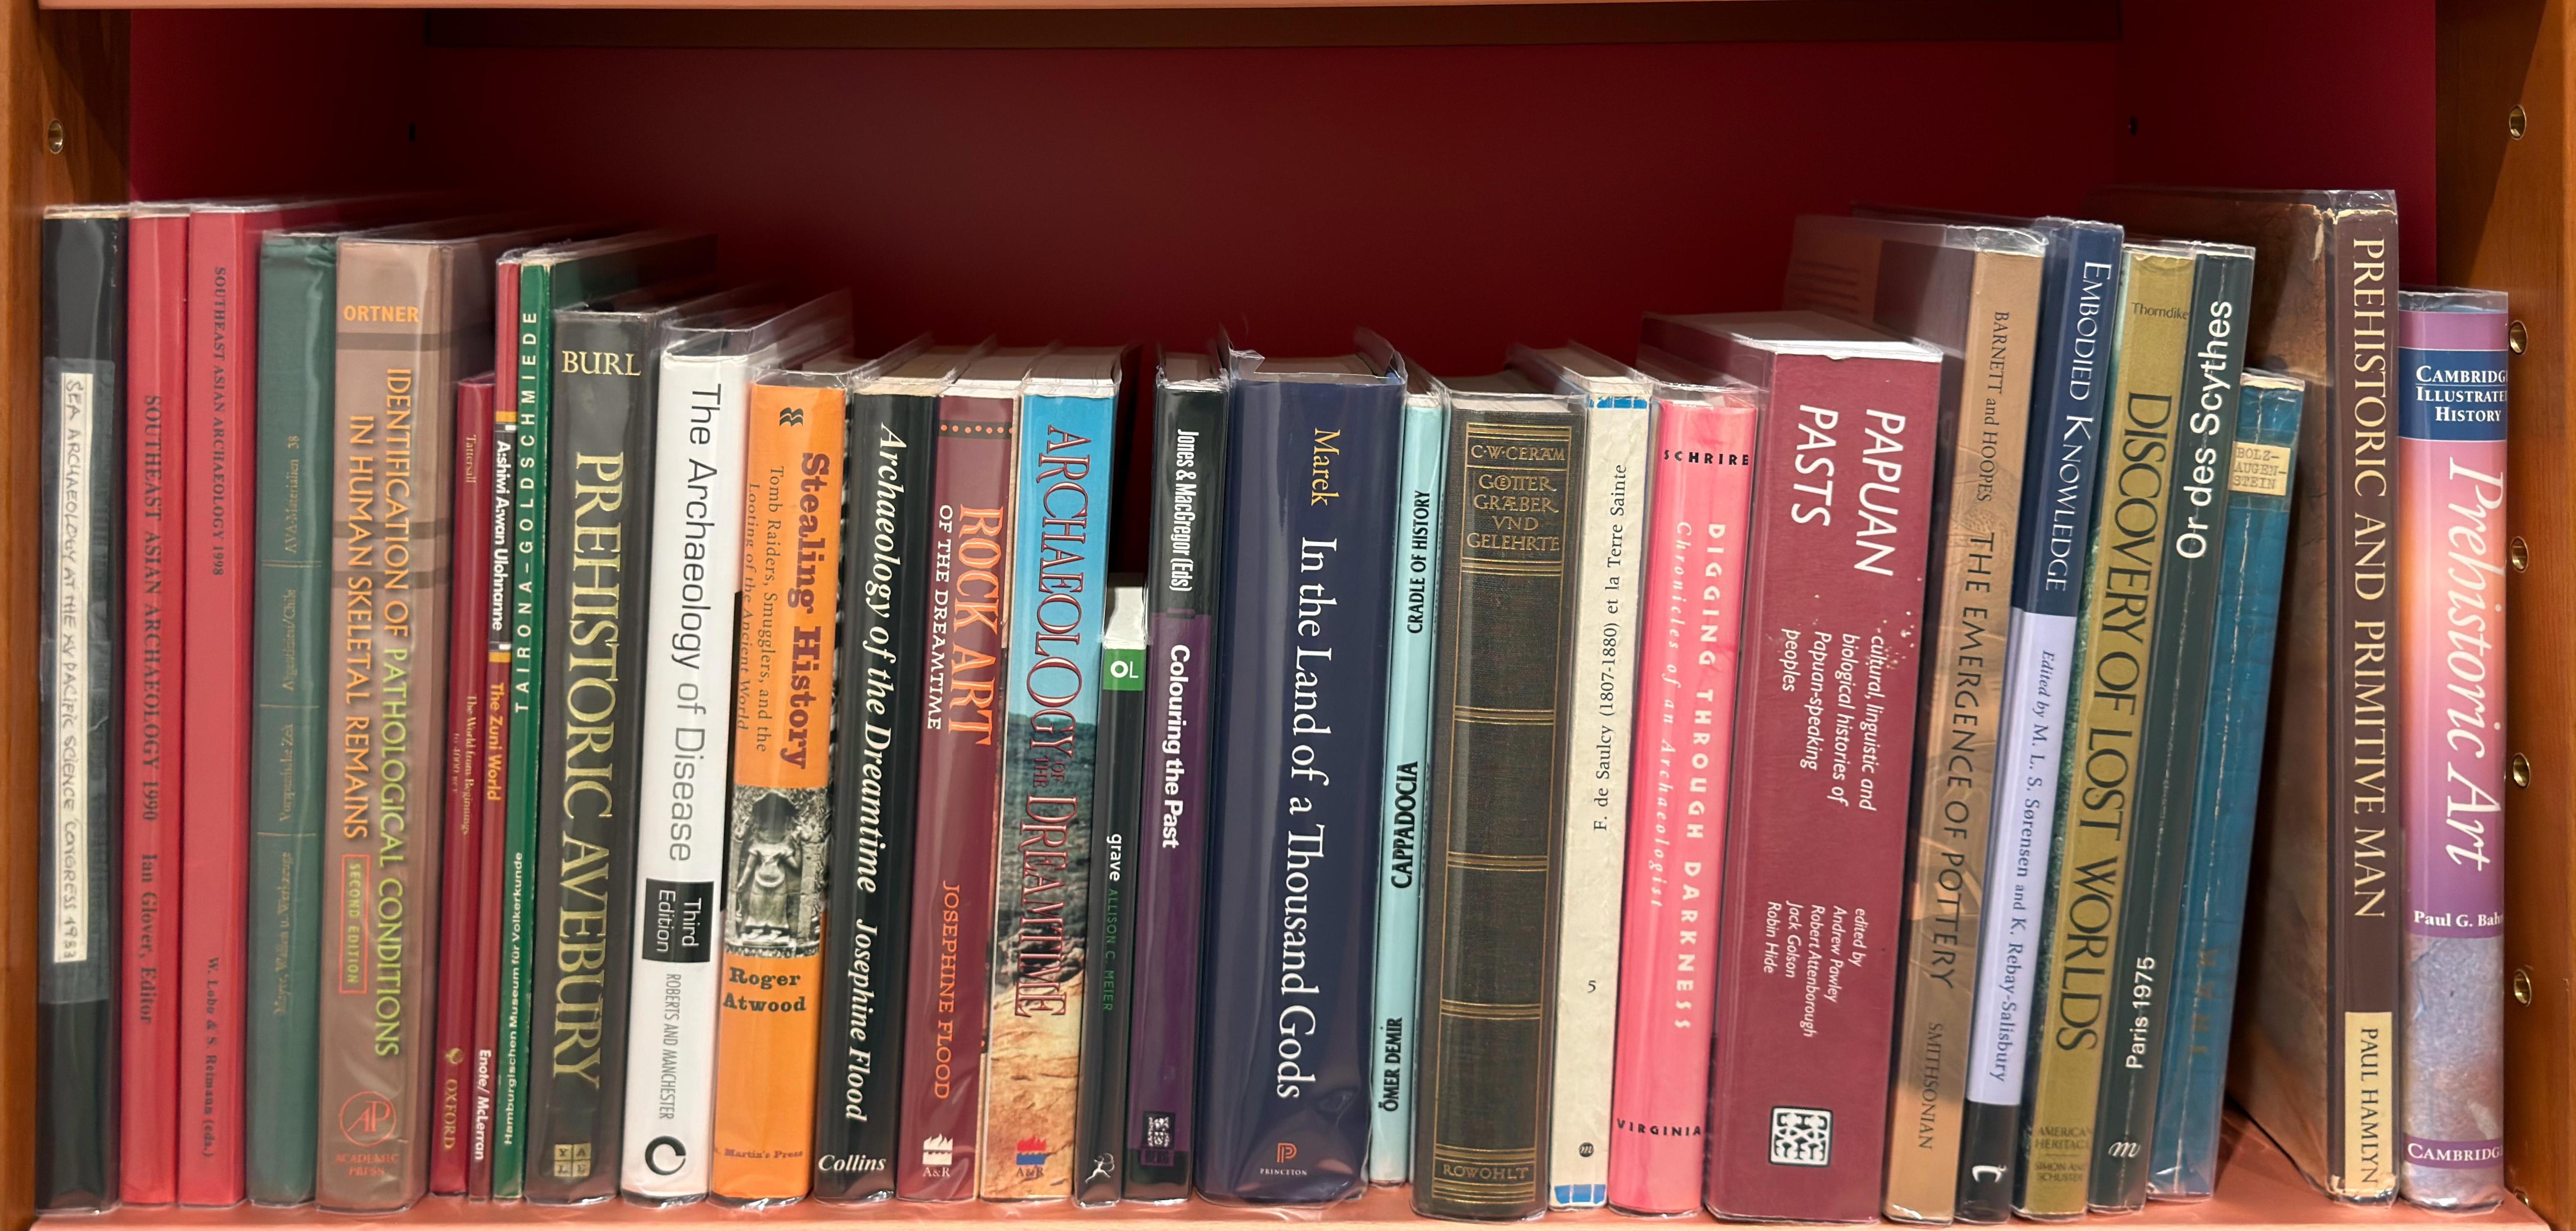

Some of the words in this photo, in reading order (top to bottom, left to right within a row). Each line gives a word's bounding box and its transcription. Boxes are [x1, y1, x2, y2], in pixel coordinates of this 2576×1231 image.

[214, 267, 226, 360] SOUTHEAST
[343, 305, 419, 322] ORTNER
[2069, 261, 2112, 400] EMBODIED
[2132, 303, 2189, 320] Thorndike
[562, 350, 641, 376] BURL
[1987, 311, 2010, 394] BARNETT
[2189, 301, 2231, 436] Scythes
[2354, 238, 2386, 497] PREHISTORIC
[65, 380, 83, 420] SEA
[213, 365, 225, 413] ASIAN
[691, 383, 721, 445] The
[1983, 398, 2000, 425] and
[2434, 406, 2502, 422] HISTORY
[144, 395, 162, 520] SOUTHEAST
[465, 435, 477, 483] Tattersall
[494, 441, 510, 494] A:shiwi
[1176, 429, 1199, 467] Jones
[1176, 469, 1196, 481] &
[1311, 427, 1340, 506] Marek
[1664, 449, 1749, 465] SCHRIRE
[1790, 404, 1839, 526] PASTS
[1976, 431, 1998, 502] HOOPES
[2236, 447, 2279, 461] BOLZ-
[63, 429, 81, 562] ARCHAEOLOGY
[212, 418, 225, 541] ARCHAEOLOGY
[384, 368, 411, 589] IDENTIFICATION
[769, 466, 784, 513] Tomb
[1610, 464, 1627, 516] Sainte
[1853, 409, 1907, 576] PAPUAN
[2046, 415, 2093, 591] KNOWLEDGE
[2183, 448, 2216, 507] des
[2232, 475, 2277, 490] STEIN
[493, 497, 508, 546] A:wan
[788, 452, 830, 613] Stealing
[865, 423, 907, 618] Archaeology
[939, 505, 954, 533] OF
[1171, 483, 1197, 555] MacGregor
[1411, 491, 1430, 550] HISTORY
[1466, 532, 1560, 551] GELEHRTE
[1492, 515, 1539, 531] VND
[2102, 391, 2172, 645] DISCOVERY
[2176, 517, 2208, 558] Or
[144, 532, 161, 594] ASIAN
[212, 545, 224, 575] 1998
[671, 458, 717, 669] Archaeology
[764, 520, 781, 586] Raiders,
[935, 538, 952, 582] THE
[953, 504, 1004, 635] ROCK
[1301, 536, 1337, 573] In
[1410, 554, 1427, 573] OF
[1607, 524, 1623, 568] Terre
[1965, 532, 1995, 593] THE
[2354, 511, 2386, 601] AND
[64, 568, 80, 588] AT
[492, 549, 508, 631] Ulohnanne
[1026, 424, 1092, 759] ARCHAEOLOGY
[1169, 558, 1194, 592] (Eds)
[1605, 577, 1620, 590] la
[1699, 523, 1726, 665] DIGGING
[64, 593, 79, 624] THE
[384, 601, 409, 636] OF
[1298, 584, 1337, 637] the
[1406, 577, 1425, 634] CRADLE
[1607, 599, 1619, 614] et
[2447, 456, 2506, 759] Prehistoric
[563, 452, 623, 818] PREHISTORIC
[758, 592, 778, 683] Smugglers,
[862, 626, 897, 664] of
[928, 589, 949, 729] DREAMTIME
[142, 603, 162, 770] ARCHAEOLOGY
[867, 667, 894, 715] the
[949, 642, 996, 745] ART
[1110, 660, 1138, 678] OL
[1293, 646, 1332, 735] Land
[1599, 623, 1621, 716] (1807-1880)
[1864, 635, 1887, 699] cultural,
[2094, 651, 2140, 716] OF
[489, 683, 504, 711] The
[677, 683, 706, 714] of
[758, 689, 772, 719] and
[780, 626, 821, 769] History
[1162, 644, 1190, 754] Colouring
[1800, 630, 1832, 770] Papuan-speaking
[1947, 606, 1988, 788] EMERGENCE
[2354, 619, 2386, 815] PRIMITIVE
[379, 648, 409, 868] PATHOLOGICAL
[488, 716, 503, 750] Zuni
[756, 726, 771, 752] the
[1595, 725, 1614, 779] Saulcy
[1859, 703, 1885, 773] linguistic
[487, 754, 502, 800] World
[1165, 758, 1184, 795] the
[1291, 745, 1330, 786] of
[1686, 689, 1714, 838] THROUGH
[2078, 728, 2133, 841] LOST
[143, 781, 159, 821] 1990
[670, 728, 706, 861] Disease
[857, 721, 891, 892] Dreamtime
[1289, 796, 1313, 814] a
[1594, 788, 1609, 807] de
[1859, 778, 1877, 811] and
[1944, 800, 1970, 839] OF
[2445, 761, 2502, 872] Art
[1162, 799, 1183, 849] Past
[1594, 816, 1607, 831] F.
[141, 853, 158, 883] Ian
[348, 863, 361, 918] SECOND
[2354, 827, 2386, 918] MAN
[139, 893, 158, 958] Glover,
[656, 889, 676, 952] Edition
[1015, 794, 1078, 1018] DREAMTIME
[1281, 824, 1325, 995] Thousand
[1765, 901, 1782, 937] Robin
[1785, 900, 1804, 930] Jack
[1808, 904, 1826, 948] Robert
[1830, 905, 1849, 955] Andrew
[1852, 908, 1869, 948] edited
[1930, 852, 1965, 989] POTTERY
[347, 926, 360, 983] EDITION
[375, 877, 403, 1055] CONDITIONS
[554, 830, 610, 1089] AVEBURY
[938, 880, 960, 1012] JOSEPHINE
[1675, 861, 1702, 1028] DARKNESS
[1763, 942, 1779, 973] Hide
[1785, 934, 1802, 978] Golson
[1848, 951, 1866, 967] by
[2056, 855, 2119, 1051] WORLDS
[139, 967, 157, 1024] Editor
[664, 974, 681, 1020] ROBERTS
[723, 992, 806, 1012] Atwood
[729, 967, 801, 989] Roger
[848, 918, 878, 1040] Josephine
[1800, 950, 1823, 1037] Attenborough
[1824, 958, 1845, 1002] Pawley
[663, 1023, 678, 1046] AND
[934, 1019, 954, 1099] FLOOD
[1277, 1005, 1316, 1097] Gods
[2360, 1028, 2378, 1082] PAUL
[660, 1049, 677, 1119] MANCHESTER
[845, 1046, 872, 1121] Flood
[444, 1079, 457, 1149] OXFORD
[1617, 1118, 1702, 1136] VIRGINIA
[2360, 1089, 2379, 1184] HAMLYN
[349, 1167, 385, 1177] PRESS
[818, 1154, 887, 1172] Collins
[922, 1167, 952, 1178] A&R
[1015, 1167, 1045, 1178] A&R
[1260, 1167, 1308, 1176] PRINCETON
[1442, 1163, 1529, 1180] ROWOHLT
